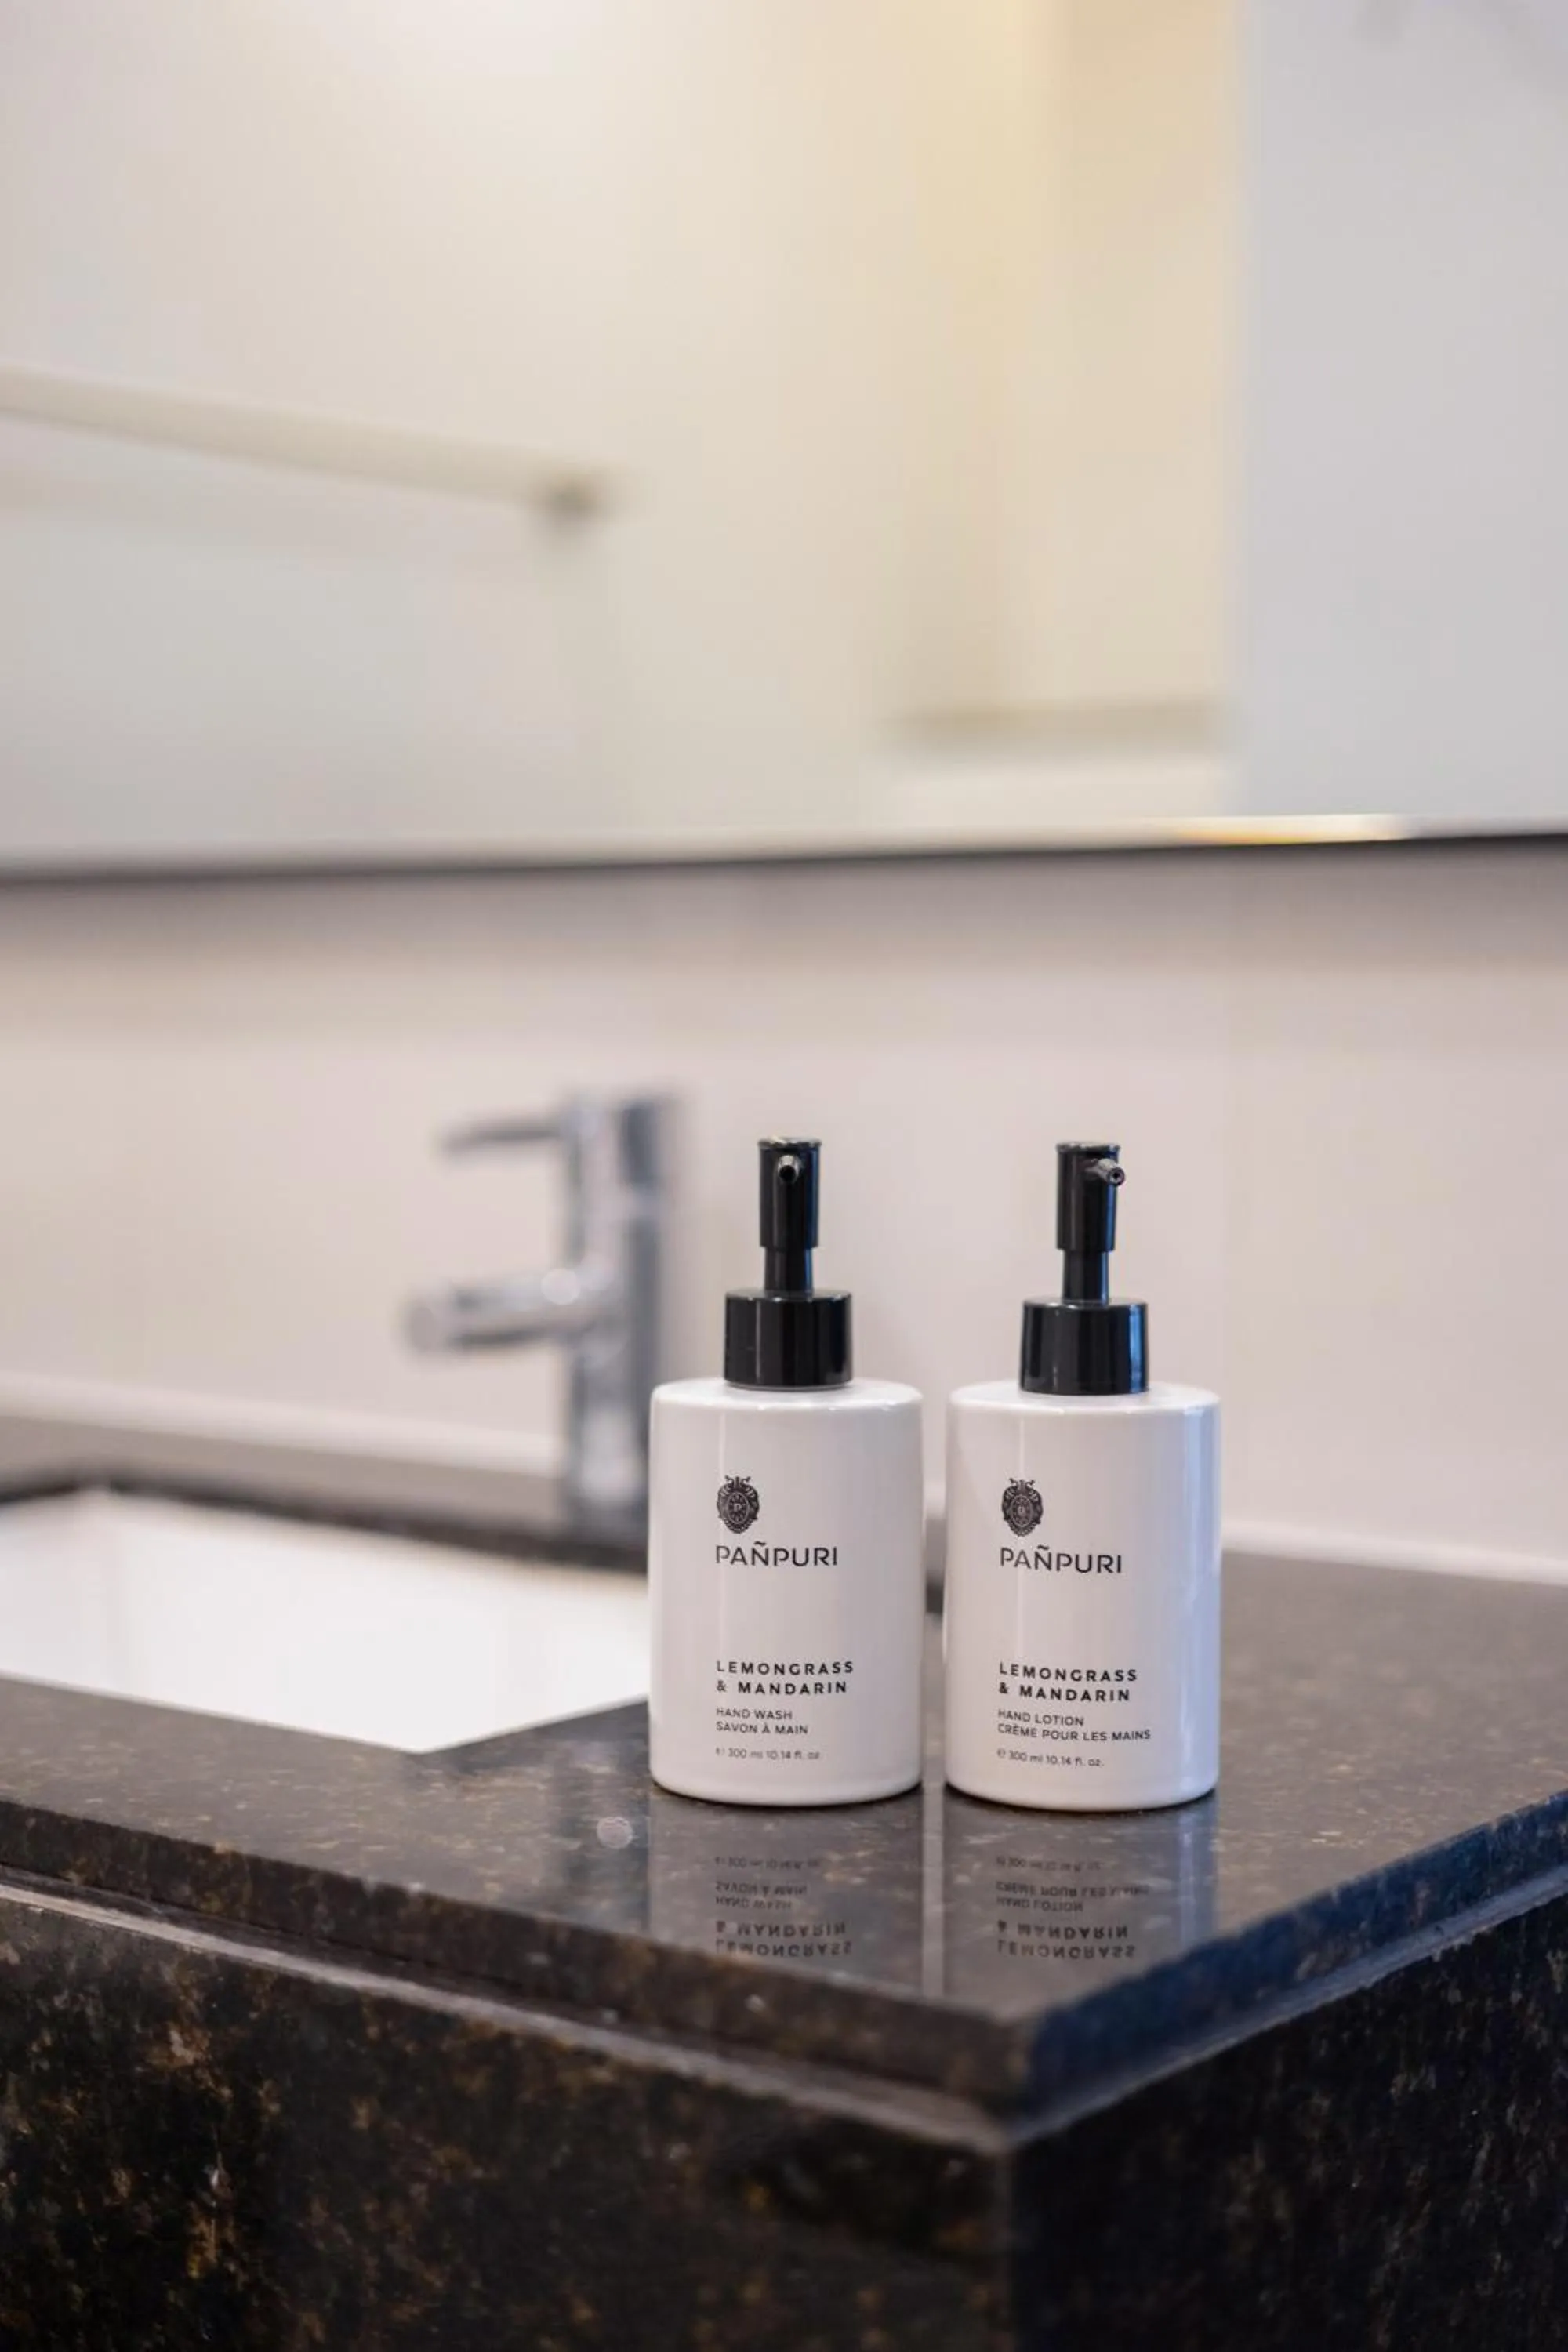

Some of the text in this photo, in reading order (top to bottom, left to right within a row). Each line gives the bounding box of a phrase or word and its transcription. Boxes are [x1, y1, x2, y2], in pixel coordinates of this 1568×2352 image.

[716, 1541, 838, 1567] PAÑPURI
[1000, 1544, 1122, 1573] PAÑPURI
[717, 1660, 854, 1675] LEMONGRASS
[999, 1661, 1138, 1682] LEMONGRASS
[716, 1679, 847, 1695] & MANDARIN
[998, 1682, 1130, 1702] & MANDARIN
[716, 1707, 793, 1720] HAND WASH
[997, 1708, 1085, 1727] HAND LOTION
[716, 1721, 808, 1734] SAVON À MAIN
[997, 1722, 1152, 1742] CRÈME POUR LES MAINS
[1008, 1749, 1028, 1762] 300
